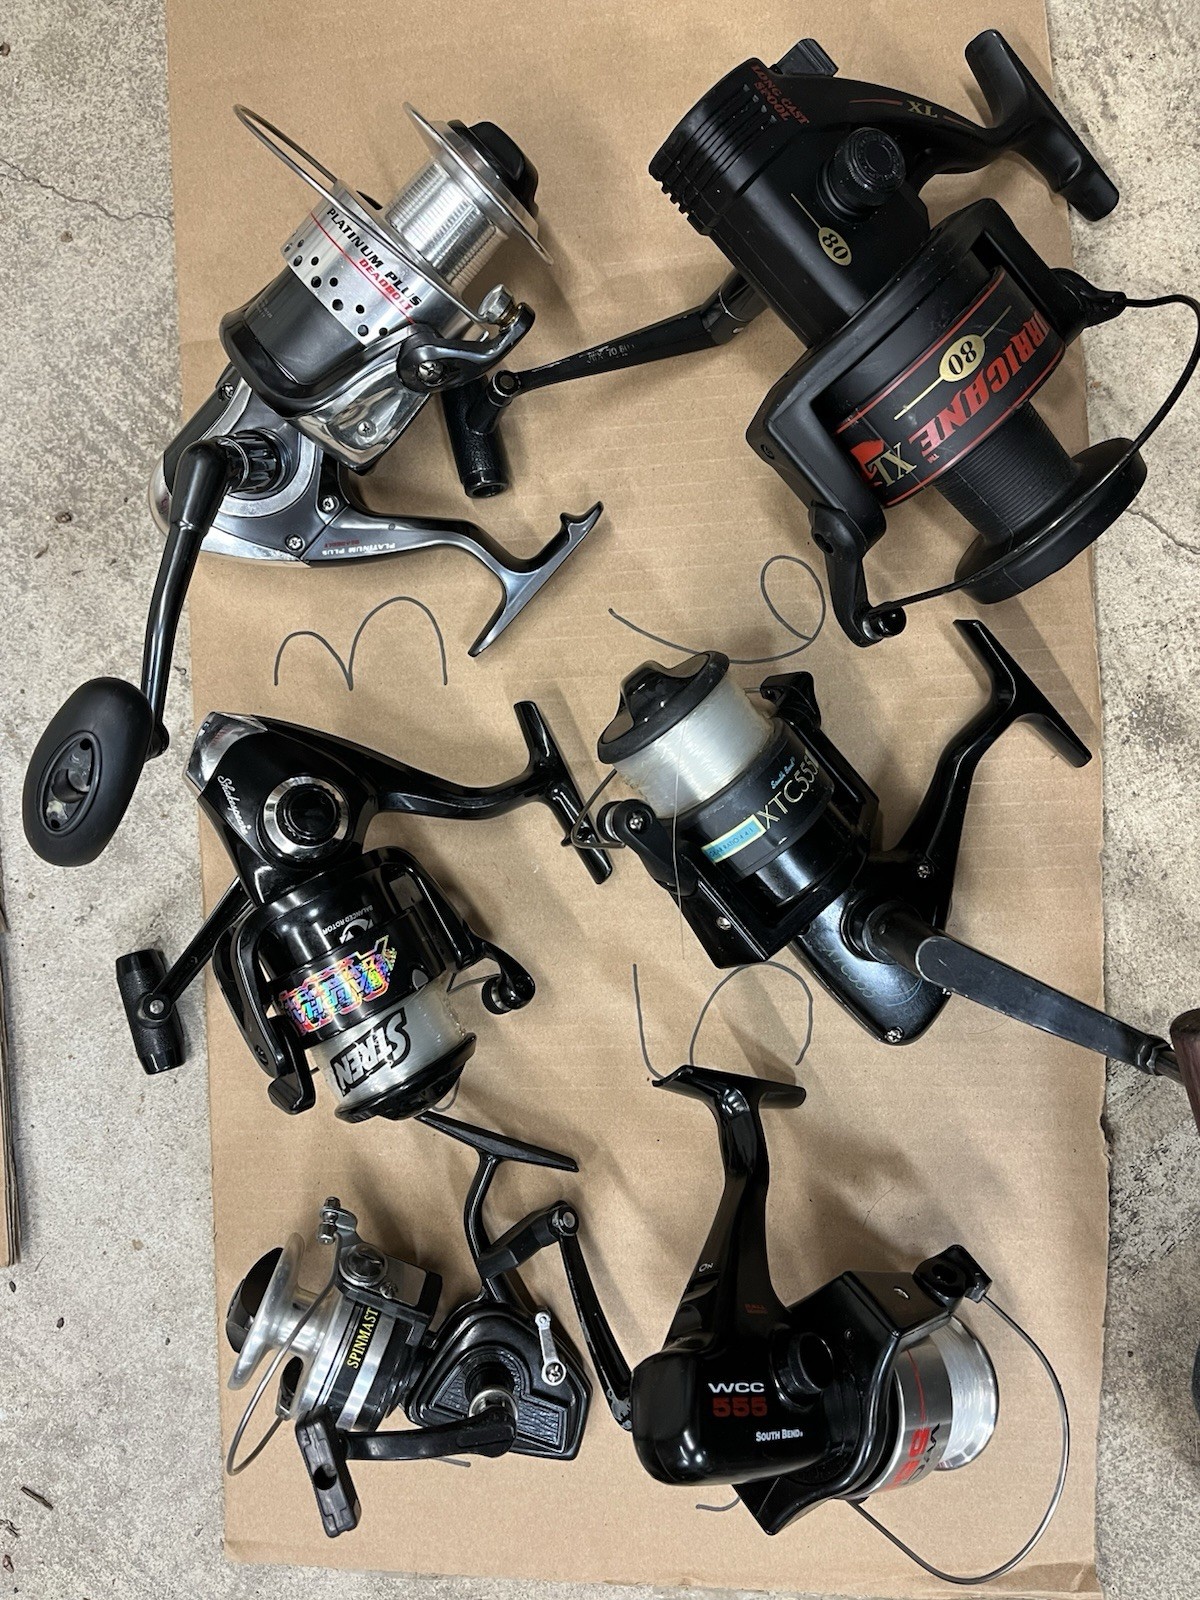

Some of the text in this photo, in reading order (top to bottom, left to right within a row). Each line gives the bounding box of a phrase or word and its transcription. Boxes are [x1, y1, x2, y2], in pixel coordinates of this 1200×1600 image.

[751, 64, 810, 123] LONG CAST
[754, 81, 789, 120] SPOOL
[907, 100, 938, 119] XL
[326, 207, 422, 306] PLATINUM PLUS
[821, 233, 849, 260] 80
[358, 258, 413, 311] DEADBOLT
[948, 340, 977, 375] 80
[907, 308, 1050, 457] URRICANE
[867, 442, 917, 487] XL
[321, 542, 396, 556] PLUS PLATINUM
[322, 918, 345, 936] ROTOR
[331, 1008, 411, 1097] STREN
[708, 1382, 765, 1393] WCC
[712, 1396, 768, 1418] 555
